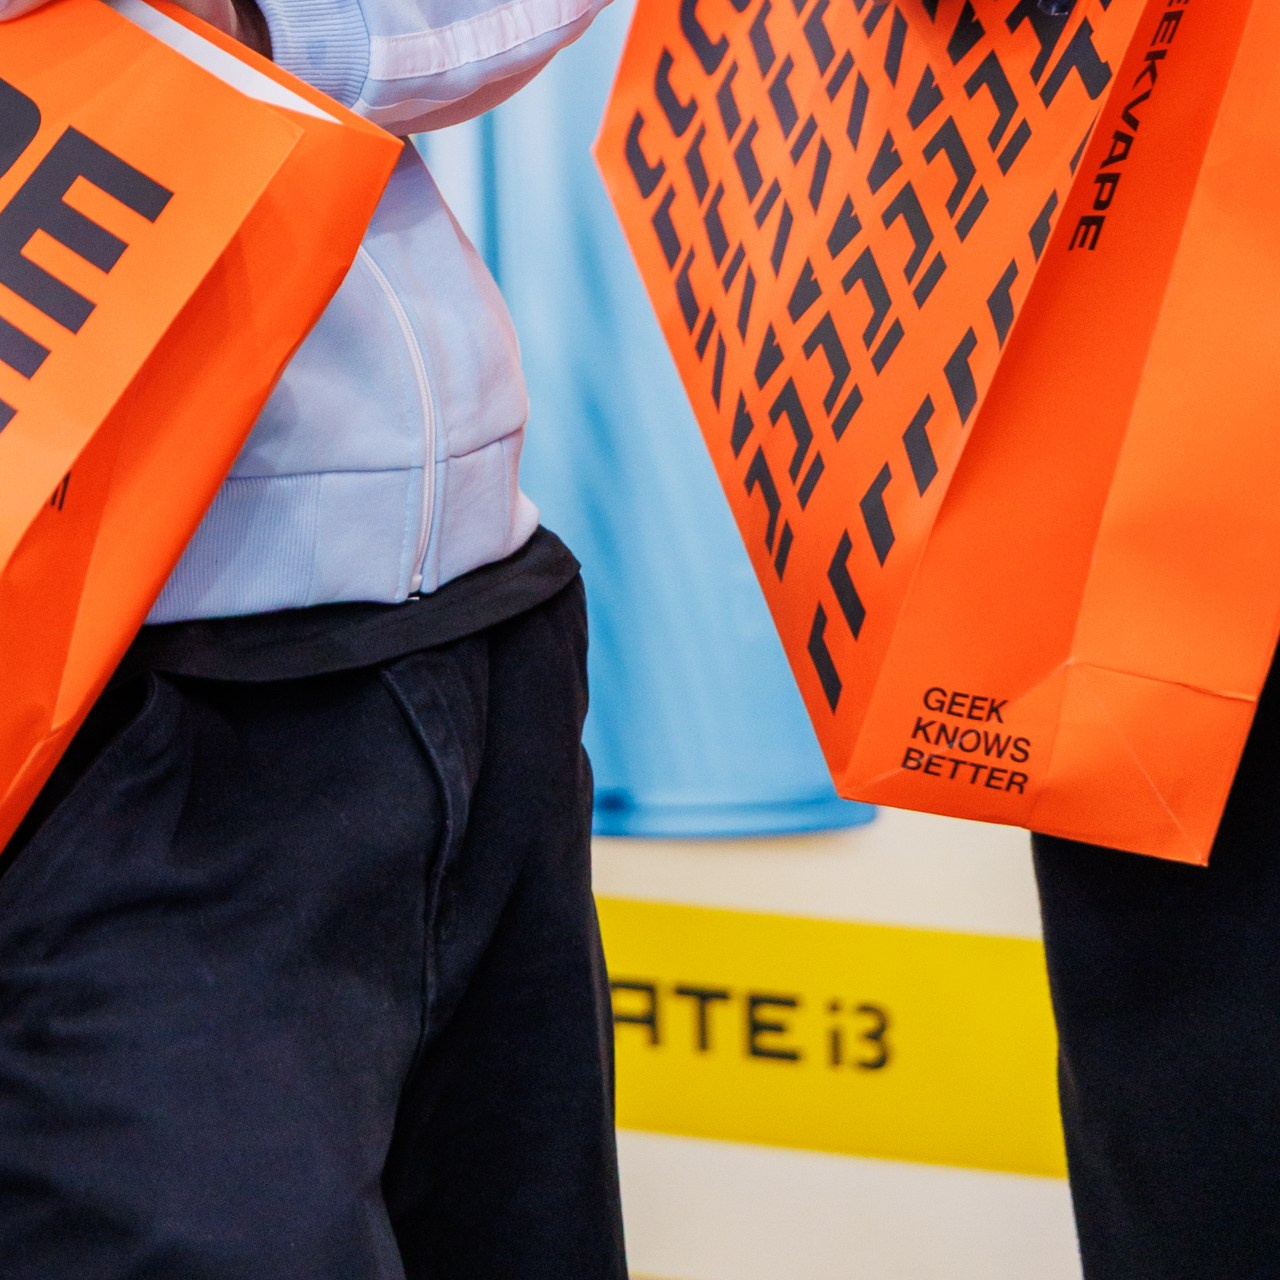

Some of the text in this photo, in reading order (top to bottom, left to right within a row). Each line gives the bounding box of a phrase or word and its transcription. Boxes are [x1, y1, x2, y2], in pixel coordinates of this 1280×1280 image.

[923, 687, 1008, 724] GEEK
[911, 716, 1031, 763] KNOWS
[901, 747, 1028, 795] BETTER
